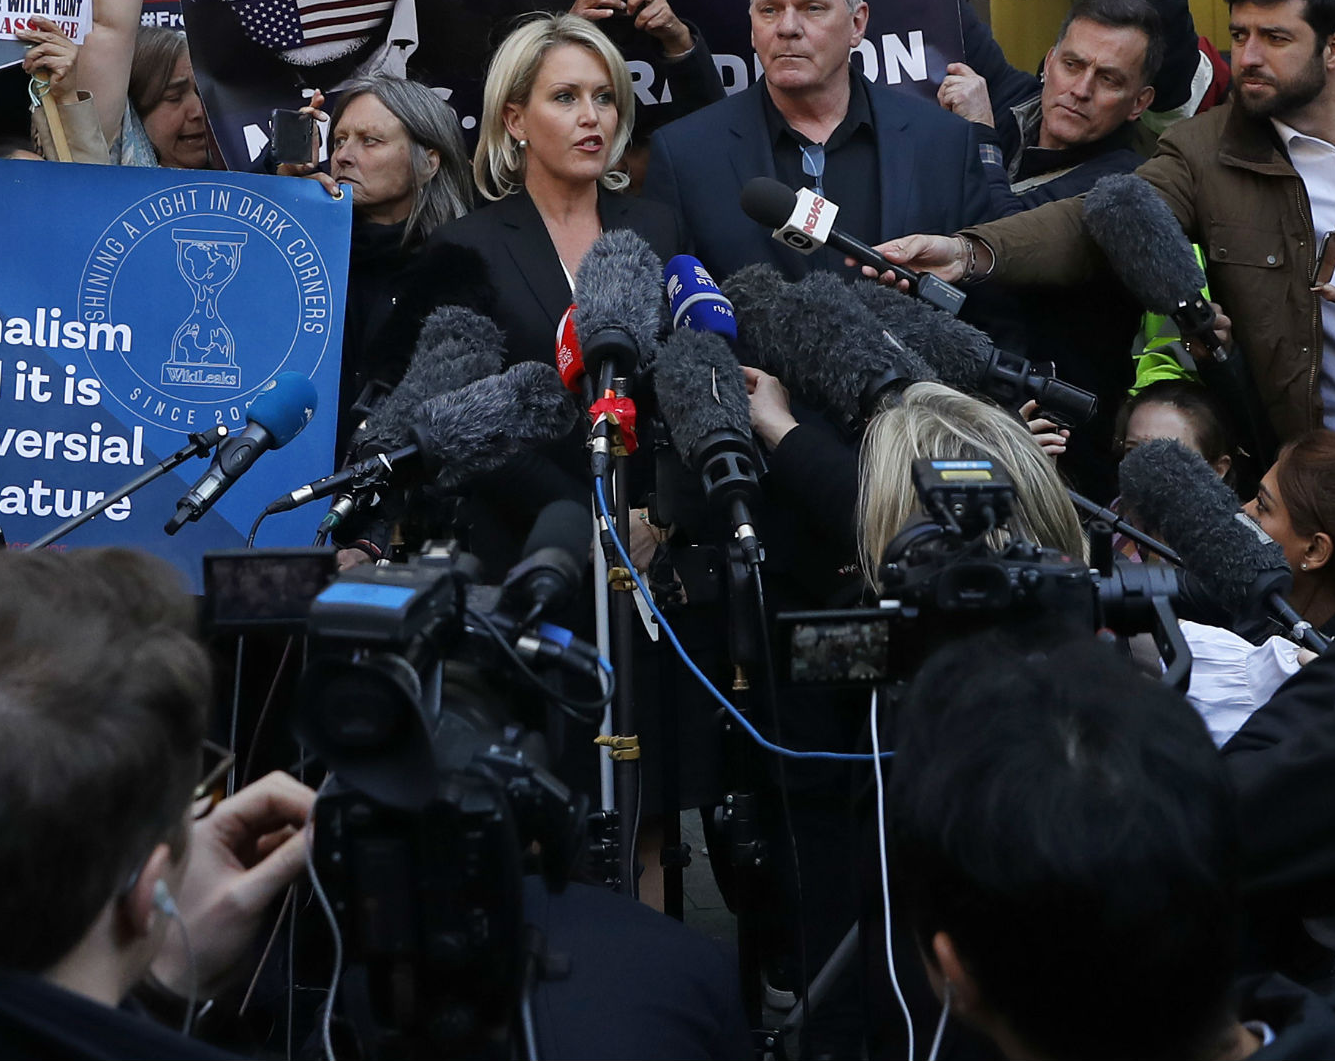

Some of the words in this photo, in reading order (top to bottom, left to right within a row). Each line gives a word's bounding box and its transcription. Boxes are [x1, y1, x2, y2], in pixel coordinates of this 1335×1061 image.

[803, 196, 825, 235] NEWS
[84, 237, 125, 322] SHINING
[122, 220, 141, 239] A
[138, 189, 198, 226] LIGHT
[210, 189, 231, 211] IN
[238, 196, 292, 240] DARK
[287, 238, 326, 334] CORNERS
[14, 360, 52, 403] it
[64, 364, 102, 406] is
[129, 387, 196, 425] SINCE
